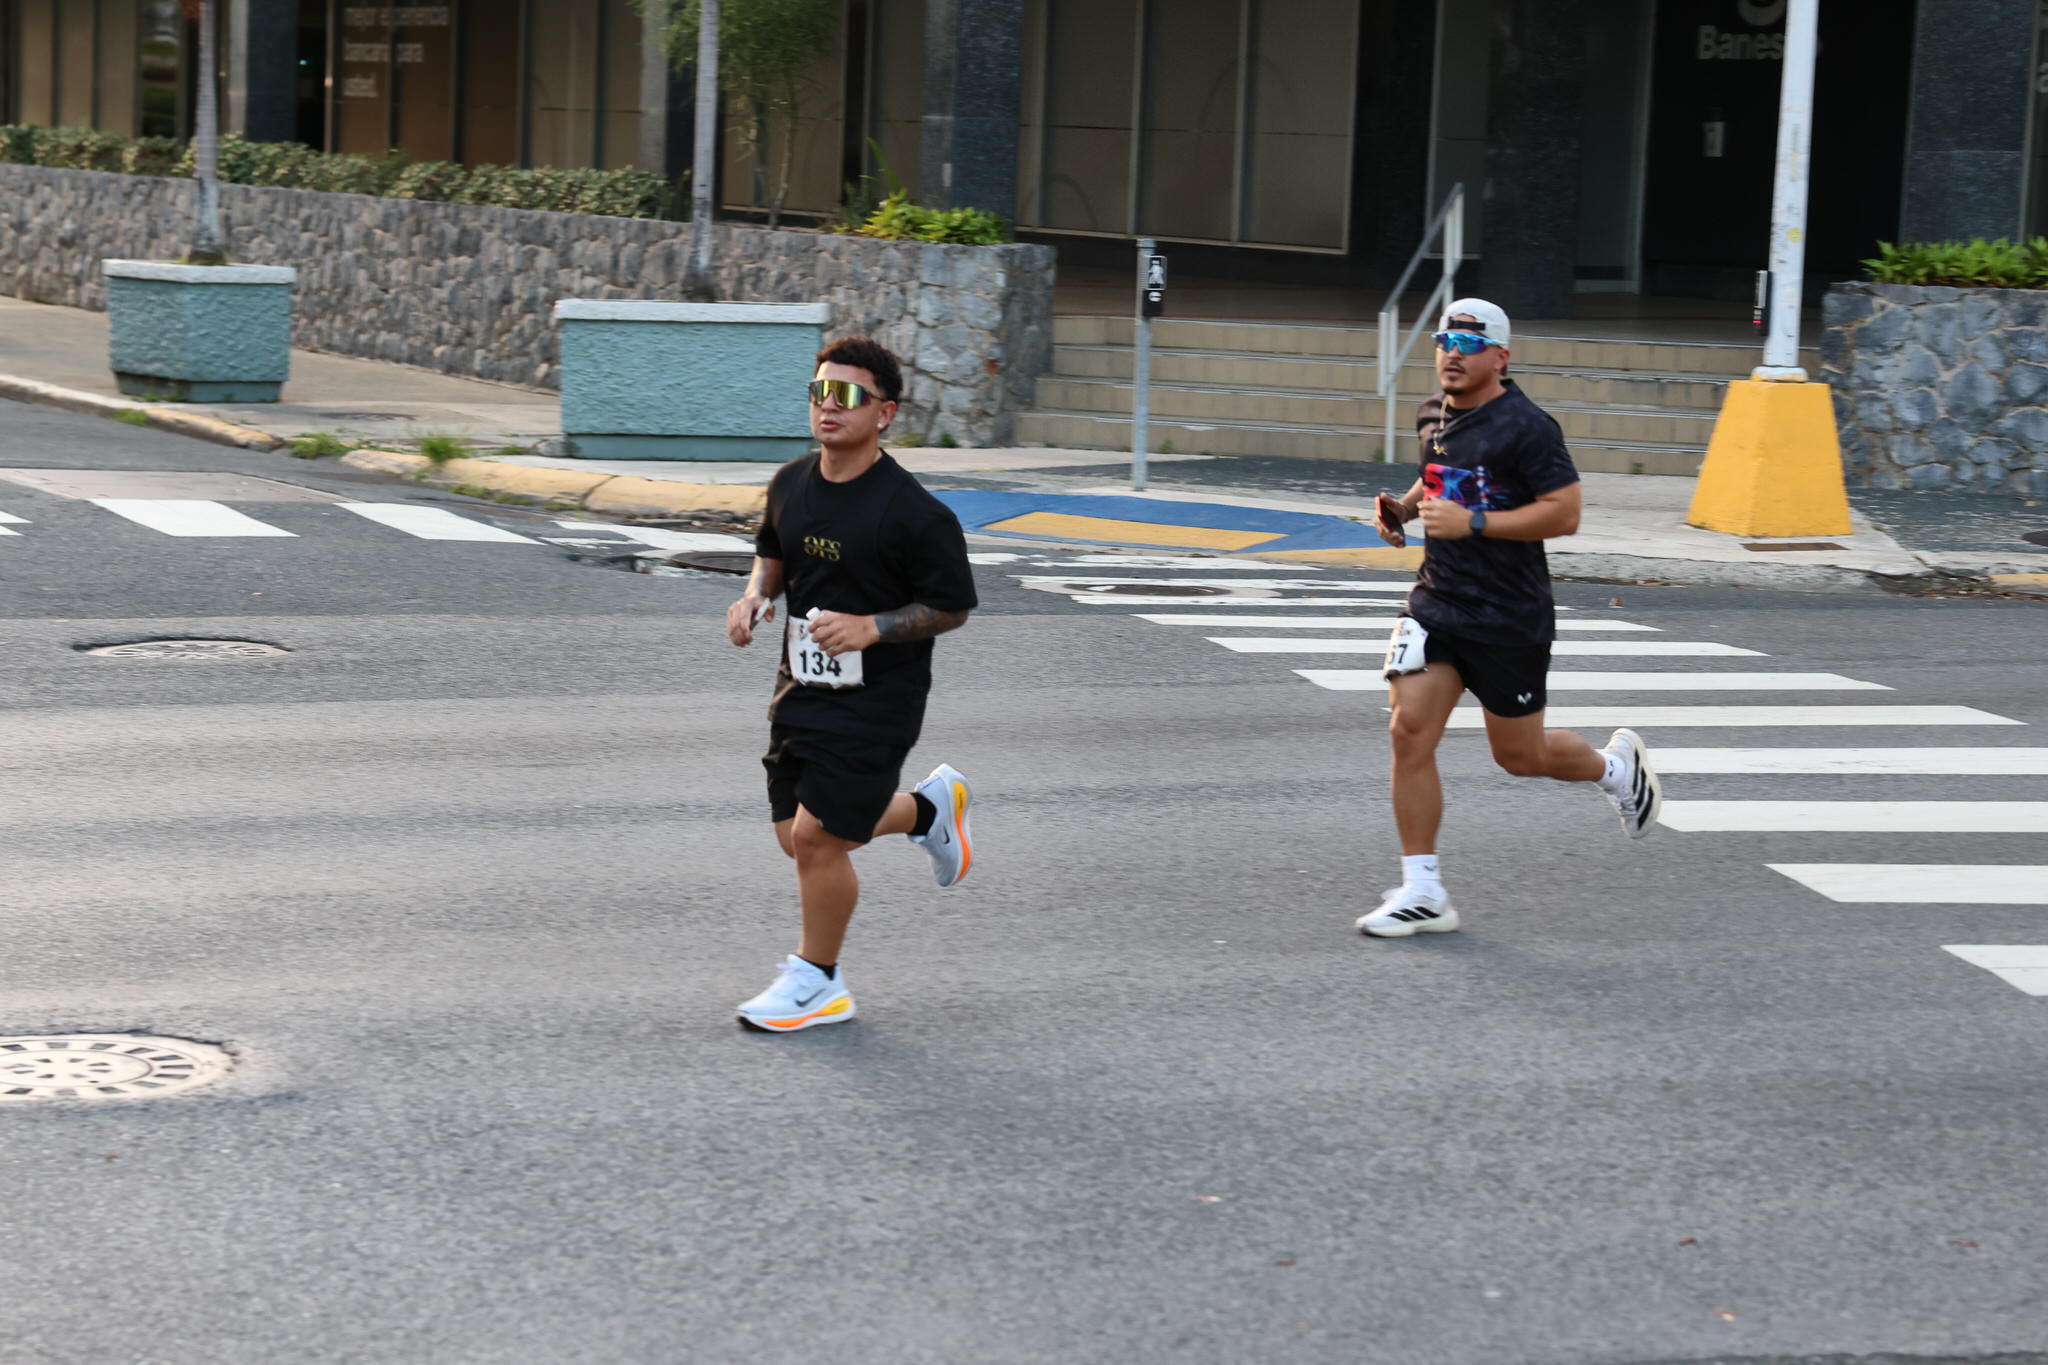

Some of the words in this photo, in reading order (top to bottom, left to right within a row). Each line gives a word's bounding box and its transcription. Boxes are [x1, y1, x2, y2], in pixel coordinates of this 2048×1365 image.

[1698, 25, 1822, 60] Banes
[1424, 463, 1472, 501] 5K
[800, 649, 842, 677] 134
